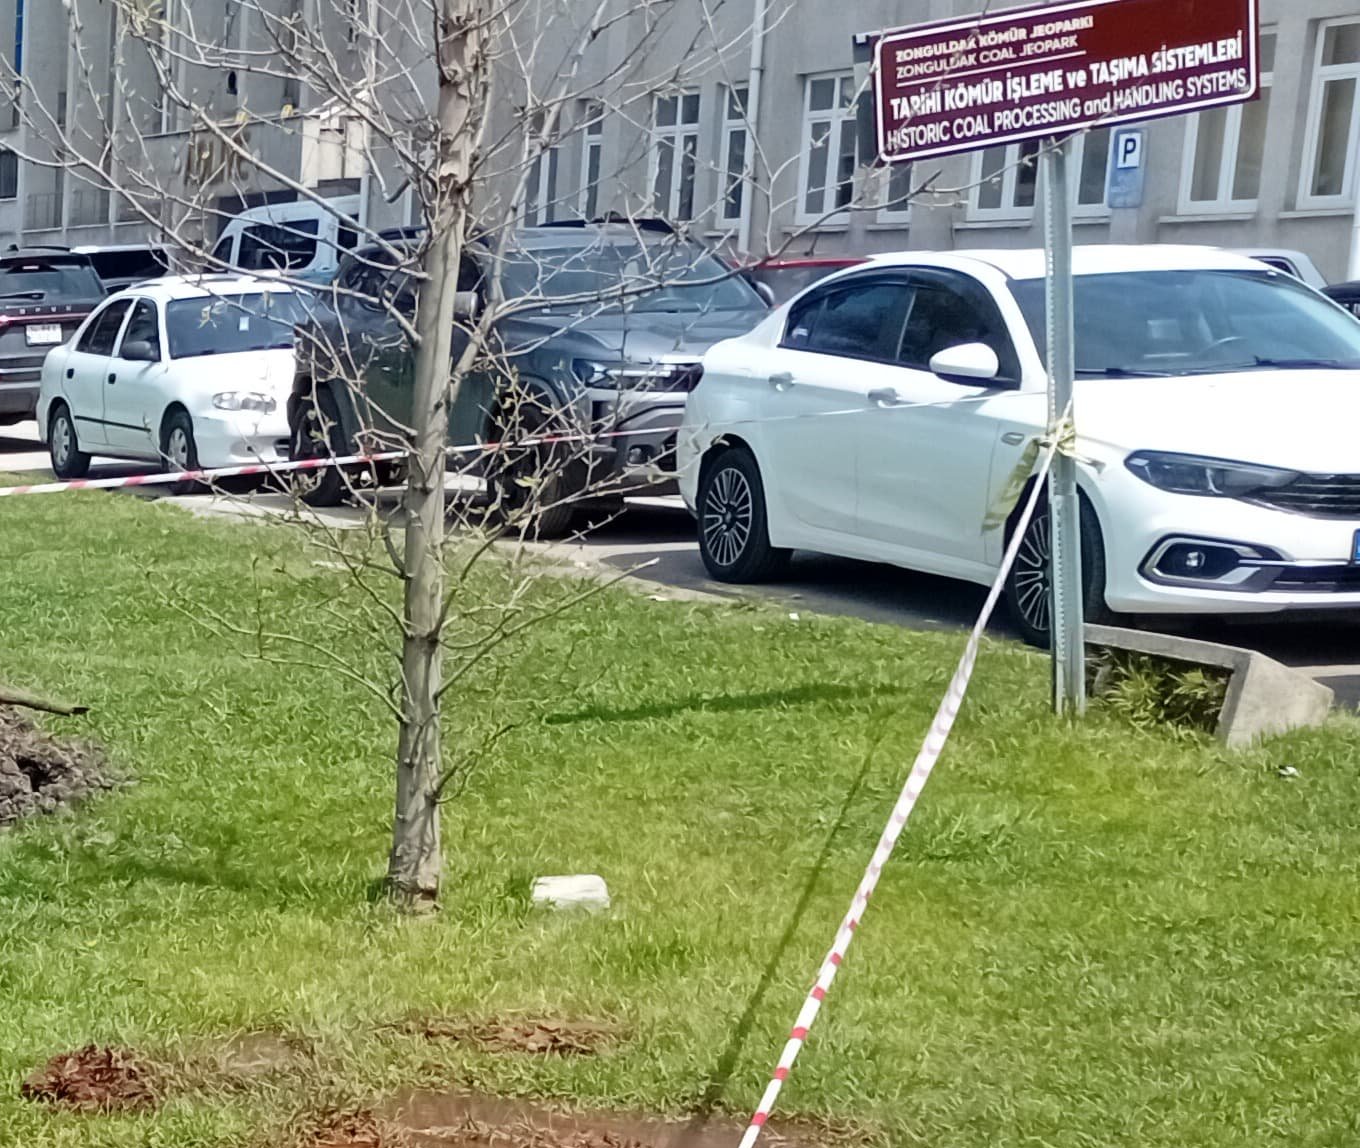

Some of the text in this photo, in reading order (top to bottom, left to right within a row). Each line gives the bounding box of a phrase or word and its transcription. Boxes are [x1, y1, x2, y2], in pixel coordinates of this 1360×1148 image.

[896, 36, 977, 62] ZONGULDAK
[980, 27, 1027, 48] KÖMÜR
[896, 35, 1078, 79] ZONGULDAK COAL JEOPARK
[945, 78, 1003, 110] KÖMÜR
[1006, 71, 1063, 104] İŞLEME
[1066, 70, 1087, 88] ve
[1089, 54, 1149, 86] TAŞIMA
[1152, 29, 1243, 73] SİSTEMLERİ
[887, 68, 1247, 151] HISTORIC COAL PROCESSING and HANDLING SYSTEMS
[1123, 138, 1137, 163] P
